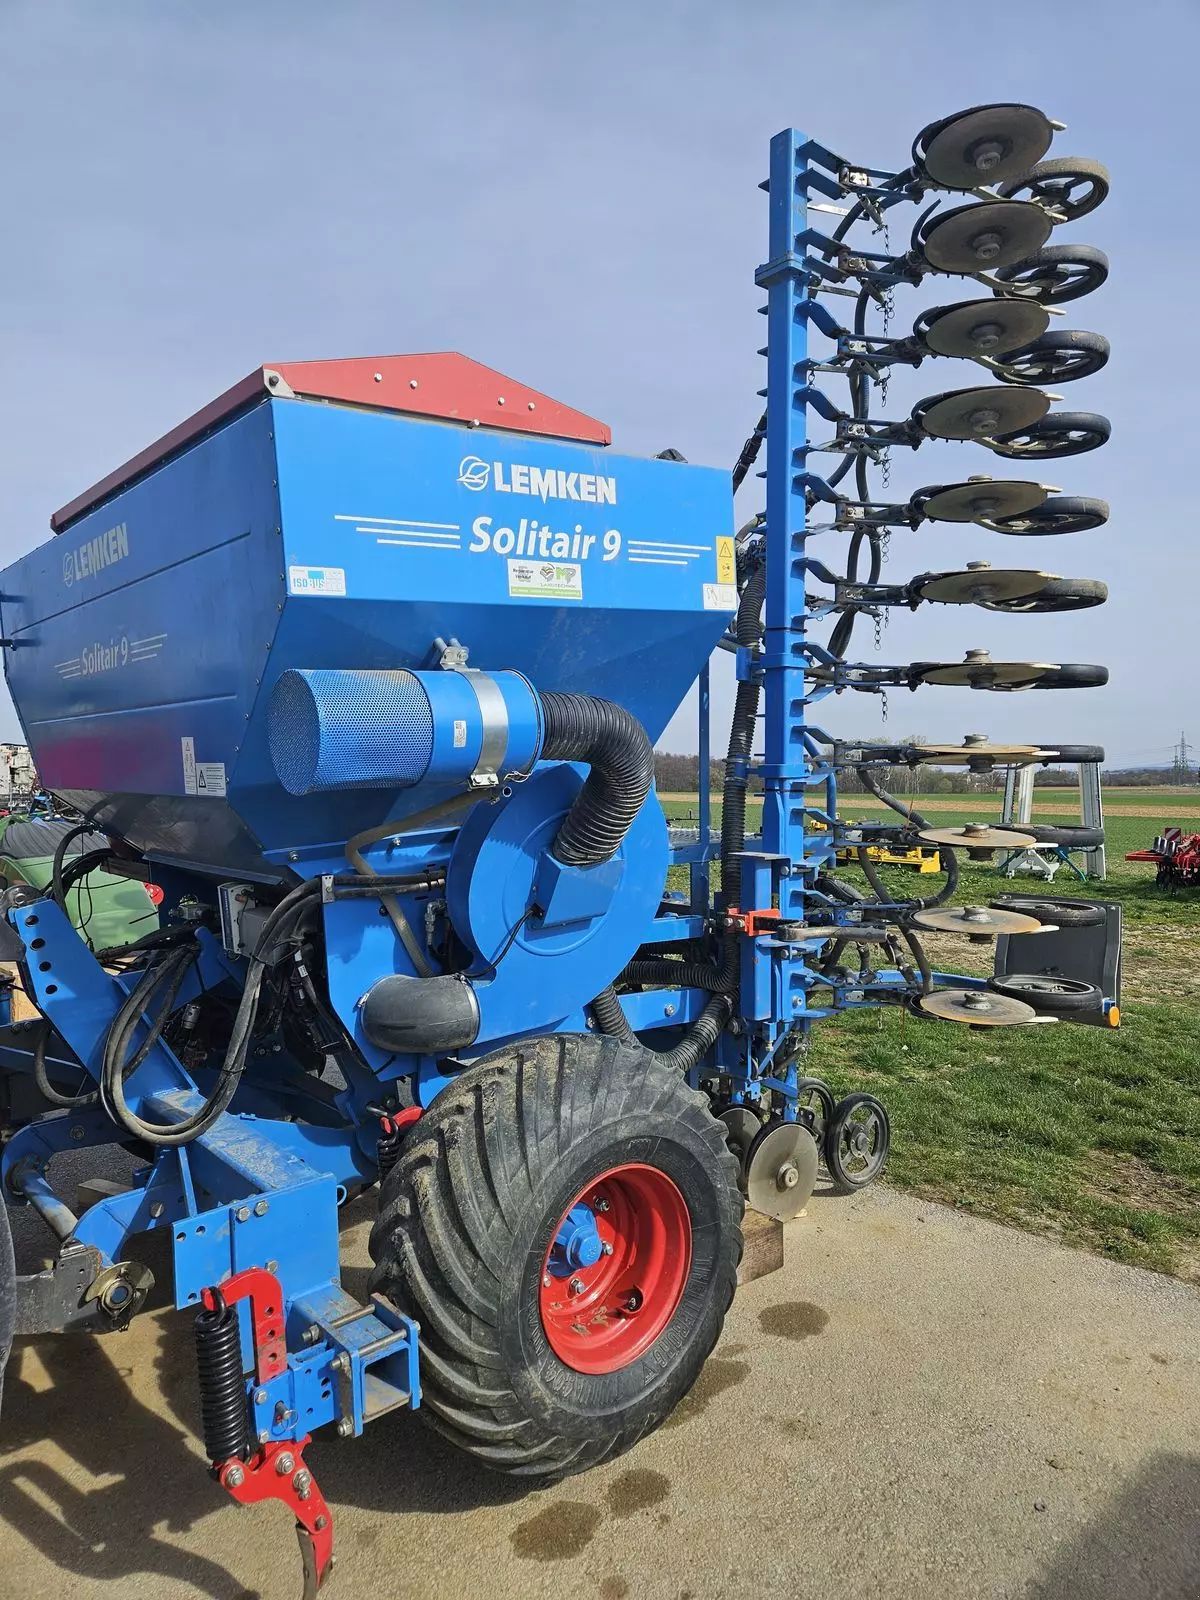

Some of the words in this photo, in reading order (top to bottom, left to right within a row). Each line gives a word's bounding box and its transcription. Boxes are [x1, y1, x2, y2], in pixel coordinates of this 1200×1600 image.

[493, 461, 617, 504] LEMKEN
[73, 522, 129, 580] LEMKEN
[469, 516, 596, 560] Solitair
[602, 529, 622, 561] 9
[82, 637, 119, 676] Solitair
[120, 636, 128, 666] 9
